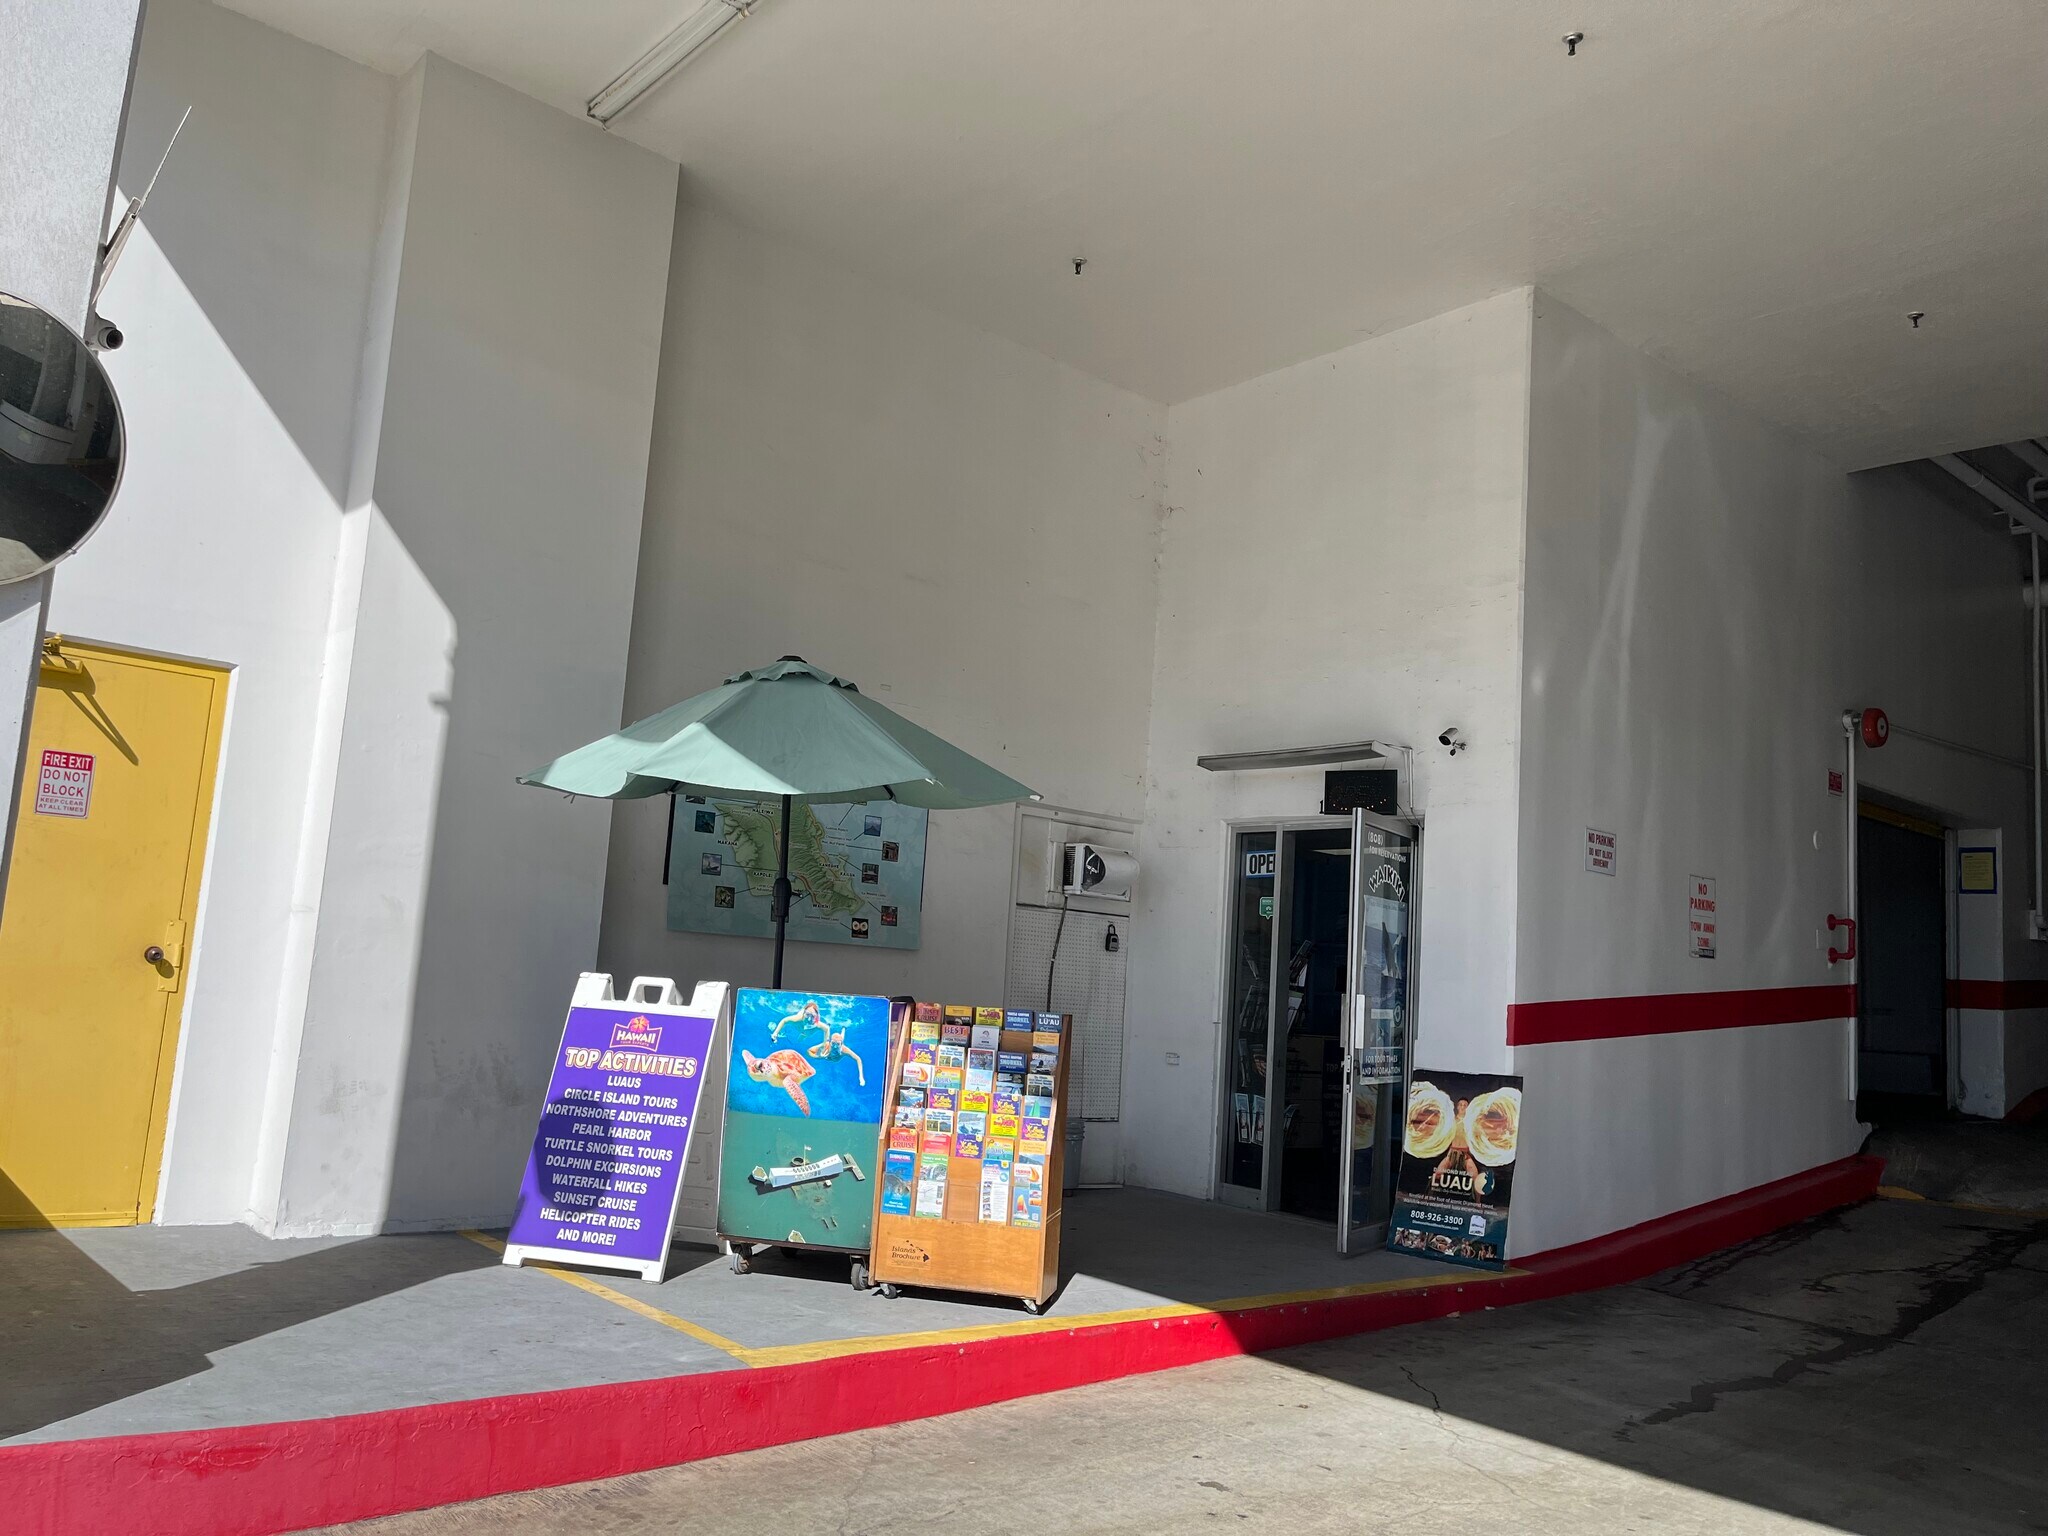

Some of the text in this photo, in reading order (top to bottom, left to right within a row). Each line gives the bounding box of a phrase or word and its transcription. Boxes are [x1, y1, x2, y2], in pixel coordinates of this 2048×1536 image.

[44, 753, 91, 770] FIRE EXIT
[44, 769, 88, 783] DO NOT
[43, 783, 84, 797] BLOCK
[1588, 832, 1614, 848] NO PARKING
[1369, 864, 1405, 902] WAIKIKI
[1698, 883, 1707, 895] NO
[1690, 897, 1715, 912] PARKING
[1690, 921, 1701, 932] TOW
[616, 1030, 657, 1044] HAWAII
[944, 1026, 964, 1036] BEST
[566, 1047, 697, 1077] TOP ACTIVITIES
[1366, 1055, 1375, 1063] FOR
[607, 1076, 642, 1088] LUAUS
[564, 1088, 679, 1109] CIRCLE ISLAND TOURS
[546, 1103, 688, 1127] NORTHSHORE ADVENTURES
[572, 1123, 652, 1141] PEARL HARBOR
[544, 1137, 673, 1161] TURTLE SNORKEL TOURS
[892, 1141, 915, 1149] CRUISE
[545, 1155, 662, 1178] DOLPHIN EXCURSIONS
[552, 1173, 648, 1195] WATERFALL HIKES
[1431, 1173, 1473, 1191] LUAU
[553, 1191, 638, 1211] SUNSET CRUISE
[540, 1208, 642, 1231] HELICOPTER RIDES
[1410, 1210, 1464, 1225] 808-926-3800
[556, 1228, 617, 1246] AND MORE!
[891, 1245, 916, 1254] Islands
[891, 1252, 921, 1260] Brochure
